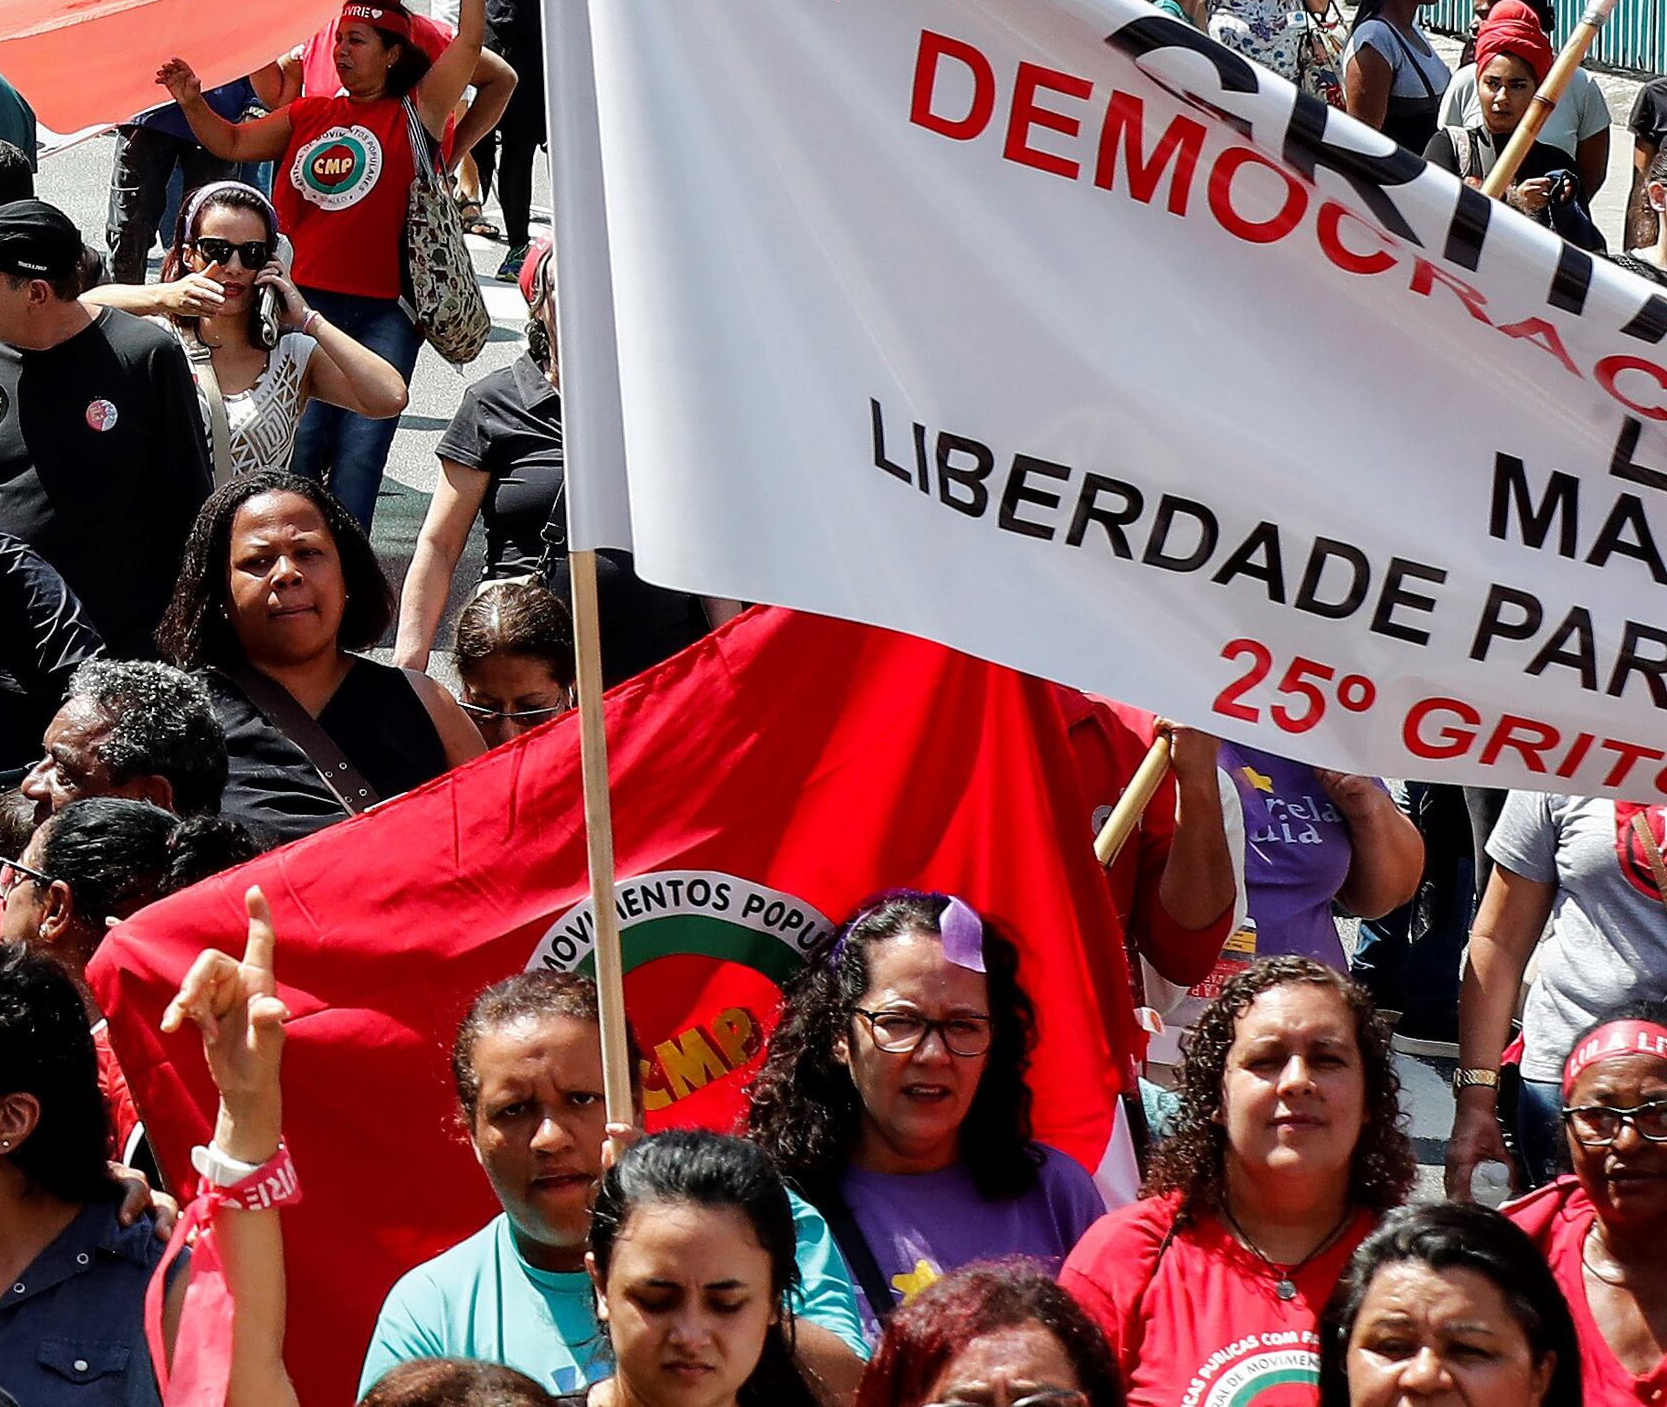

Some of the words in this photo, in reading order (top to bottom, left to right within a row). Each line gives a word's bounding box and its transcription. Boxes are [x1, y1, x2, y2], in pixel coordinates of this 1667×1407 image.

[313, 157, 354, 175] CMP
[870, 397, 1449, 647] LIBERDADE
[1212, 638, 1377, 734] 25º
[1570, 1032, 1630, 1081] LULA
[1260, 1330, 1300, 1347] COM
[1226, 1373, 1244, 1388] DE
